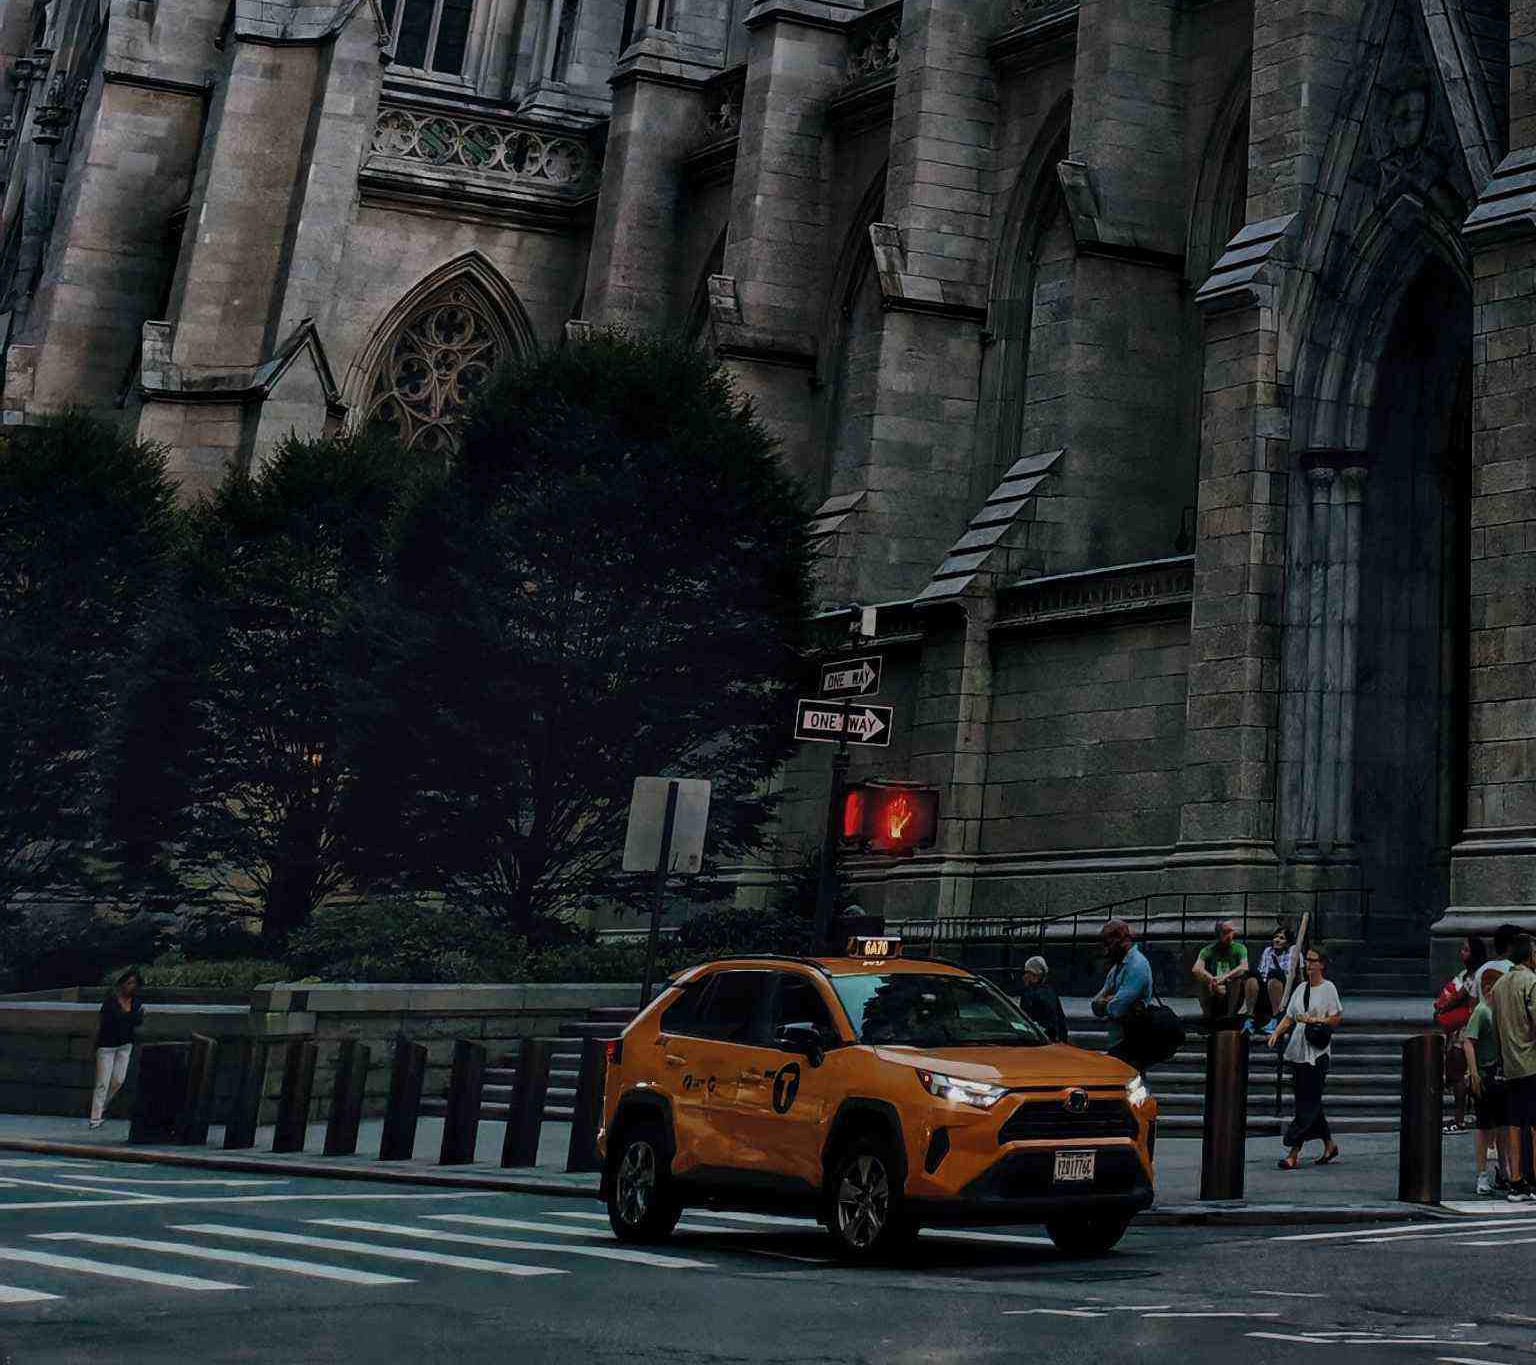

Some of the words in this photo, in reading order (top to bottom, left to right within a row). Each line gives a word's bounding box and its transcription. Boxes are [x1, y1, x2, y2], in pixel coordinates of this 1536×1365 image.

[827, 672, 845, 688] ONE
[852, 668, 870, 685] WAY
[811, 713, 837, 729] ONE
[847, 718, 877, 733] WAY
